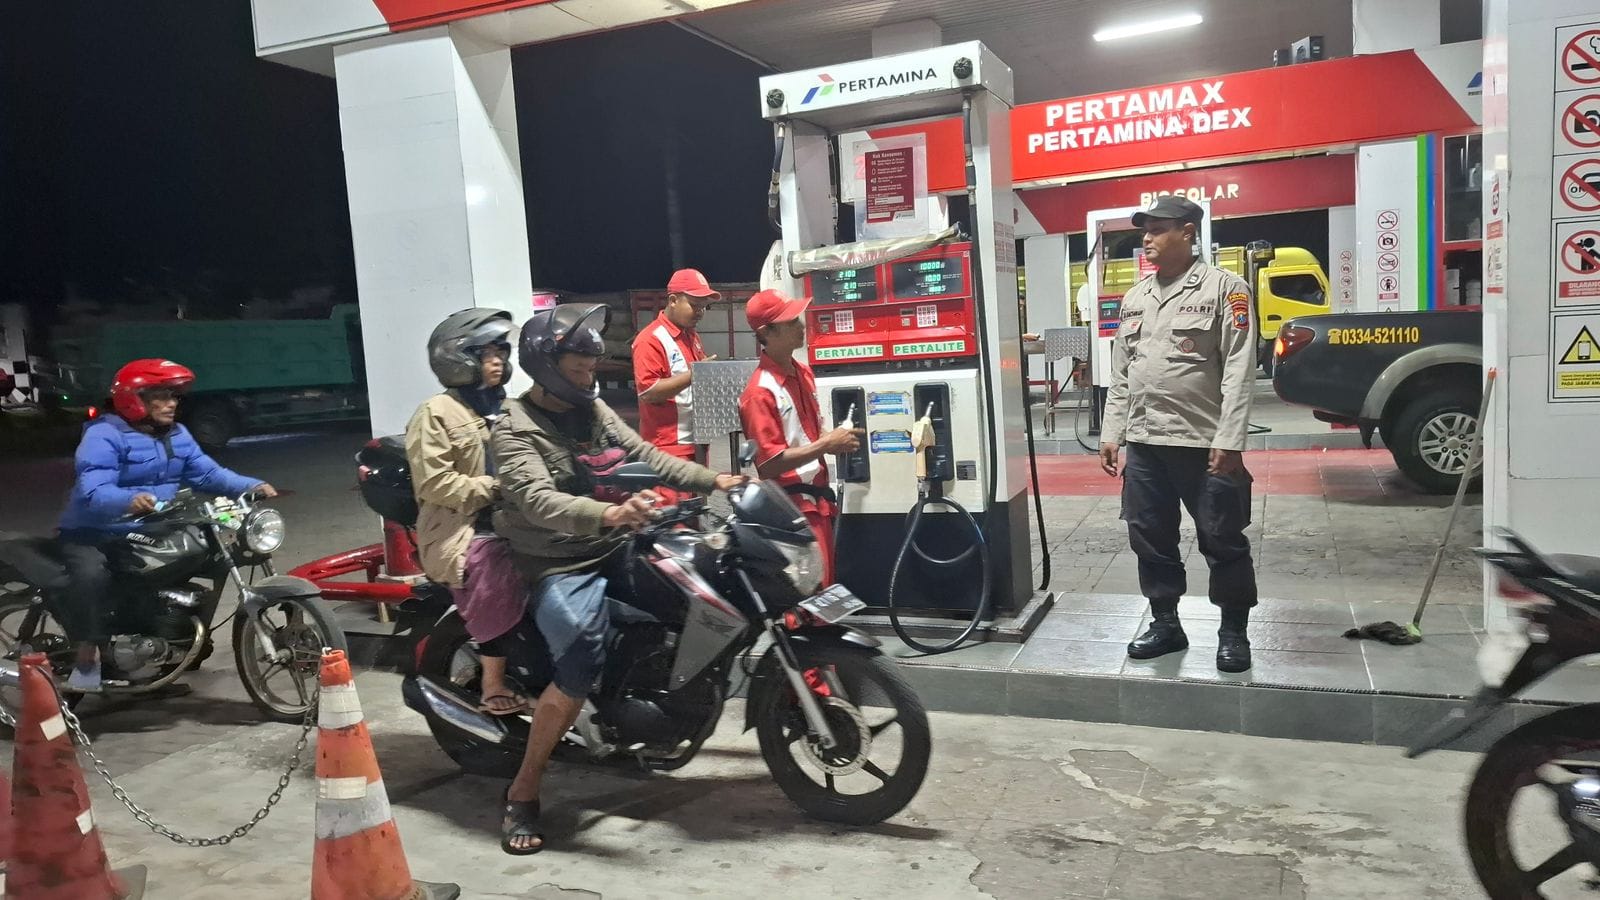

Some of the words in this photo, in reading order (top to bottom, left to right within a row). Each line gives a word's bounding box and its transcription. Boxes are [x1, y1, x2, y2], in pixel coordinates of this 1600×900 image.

[839, 67, 938, 93] PERTAMINA
[1045, 80, 1225, 127] PERTAMAX
[1028, 119, 1185, 154] PERTAMINA
[1193, 106, 1252, 134] DEX
[1178, 305, 1211, 314] POLRI
[1341, 326, 1420, 345] 0334-521110
[815, 345, 883, 359] PERTALITE
[893, 341, 965, 355] PERTALITE
[126, 532, 156, 546] SUZUKI
